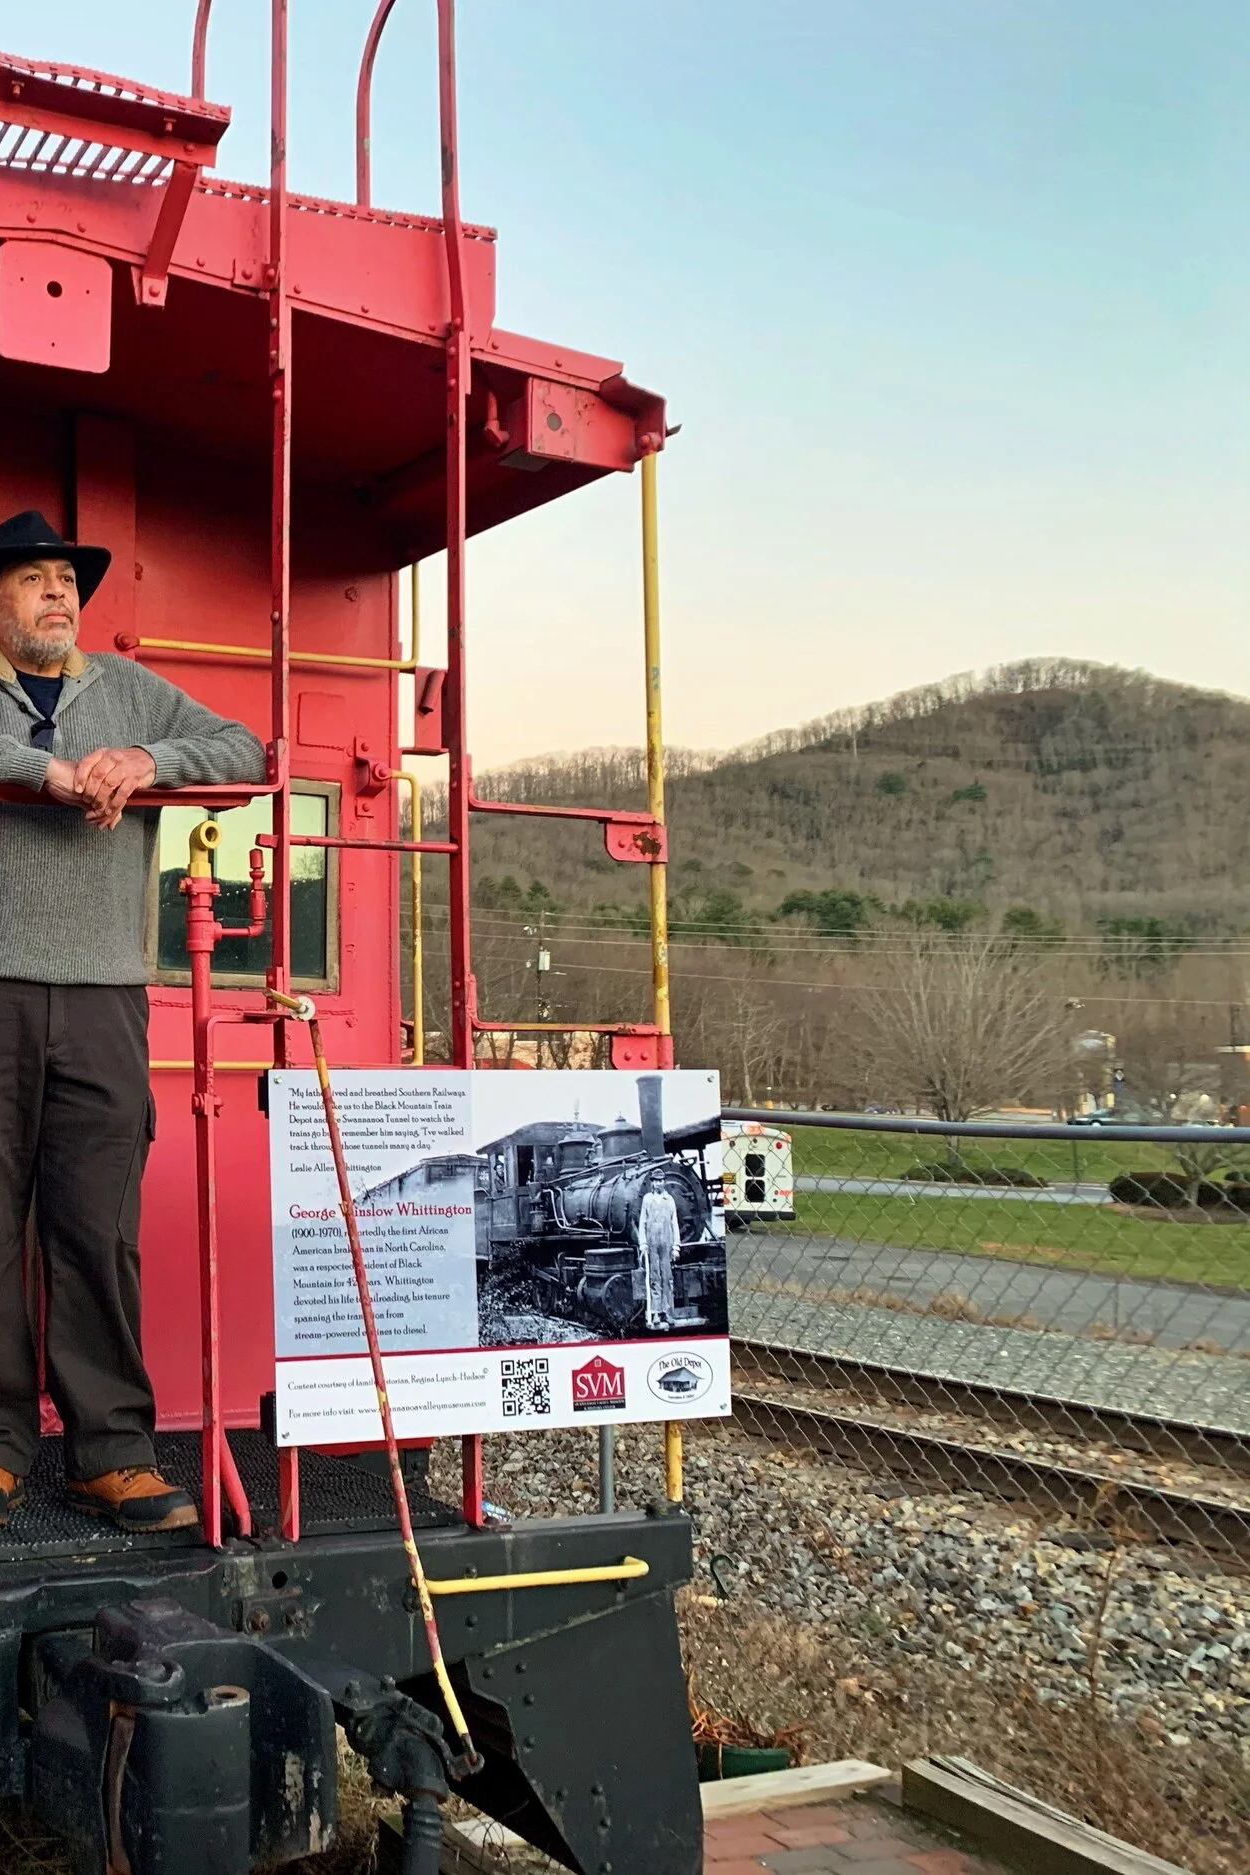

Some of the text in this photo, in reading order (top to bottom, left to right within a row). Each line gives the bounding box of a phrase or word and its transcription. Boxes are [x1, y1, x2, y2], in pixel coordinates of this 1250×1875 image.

[305, 1088, 321, 1097] fath
[332, 1088, 348, 1097] ived
[349, 1088, 363, 1097] and
[365, 1088, 397, 1097] breathed
[398, 1088, 431, 1097] Southern
[289, 1101, 301, 1110] He
[332, 1101, 343, 1110] ke
[362, 1101, 373, 1110] the
[374, 1101, 396, 1110] Black
[397, 1101, 432, 1110] Mountain
[433, 1101, 452, 1110] Train
[289, 1114, 312, 1125] Depot
[342, 1114, 384, 1123] Swannanoa
[385, 1114, 410, 1123] Tunnel
[411, 1115, 419, 1123] to
[420, 1114, 442, 1123] watch
[443, 1113, 455, 1123] the
[341, 1127, 378, 1137] remember
[379, 1127, 393, 1136] him
[437, 1127, 464, 1136] walked
[290, 1142, 309, 1150] track
[311, 1142, 333, 1152] throug
[341, 1141, 360, 1150] those
[362, 1140, 388, 1150] tunnels
[390, 1143, 409, 1151] many
[290, 1162, 381, 1173] Leslie Allen hittington
[289, 1204, 336, 1221] George
[396, 1201, 472, 1218] Whittington
[344, 1226, 386, 1237] rortedly
[387, 1226, 401, 1236] the
[402, 1226, 417, 1235] first
[418, 1225, 449, 1235] African
[292, 1245, 333, 1255] American
[334, 1244, 375, 1254] brakan
[376, 1245, 383, 1253] in
[385, 1242, 409, 1252] North
[364, 1260, 388, 1269] sident
[389, 1259, 397, 1269] of
[398, 1258, 422, 1268] Black
[293, 1279, 332, 1289] Mountain
[334, 1278, 345, 1287] for
[346, 1277, 357, 1287] 42
[385, 1275, 434, 1287] Whittington
[293, 1295, 327, 1306] devoted
[328, 1295, 340, 1304] his
[341, 1294, 354, 1304] life
[370, 1292, 411, 1303] ailroading,
[412, 1292, 423, 1301] his
[425, 1292, 450, 1300] tenure
[294, 1309, 404, 1324] spanning the tranion from
[294, 1327, 360, 1340] stream-powered
[362, 1328, 392, 1337] eines
[394, 1327, 402, 1335] to
[659, 1357, 702, 1370] The Old Depot
[288, 1381, 316, 1390] Content
[348, 1379, 355, 1387] of
[356, 1378, 373, 1386] famil
[386, 1377, 410, 1385] storian,
[411, 1374, 435, 1385] Regina
[576, 1372, 623, 1398] SVM
[289, 1409, 301, 1418] For
[322, 1407, 338, 1416] info
